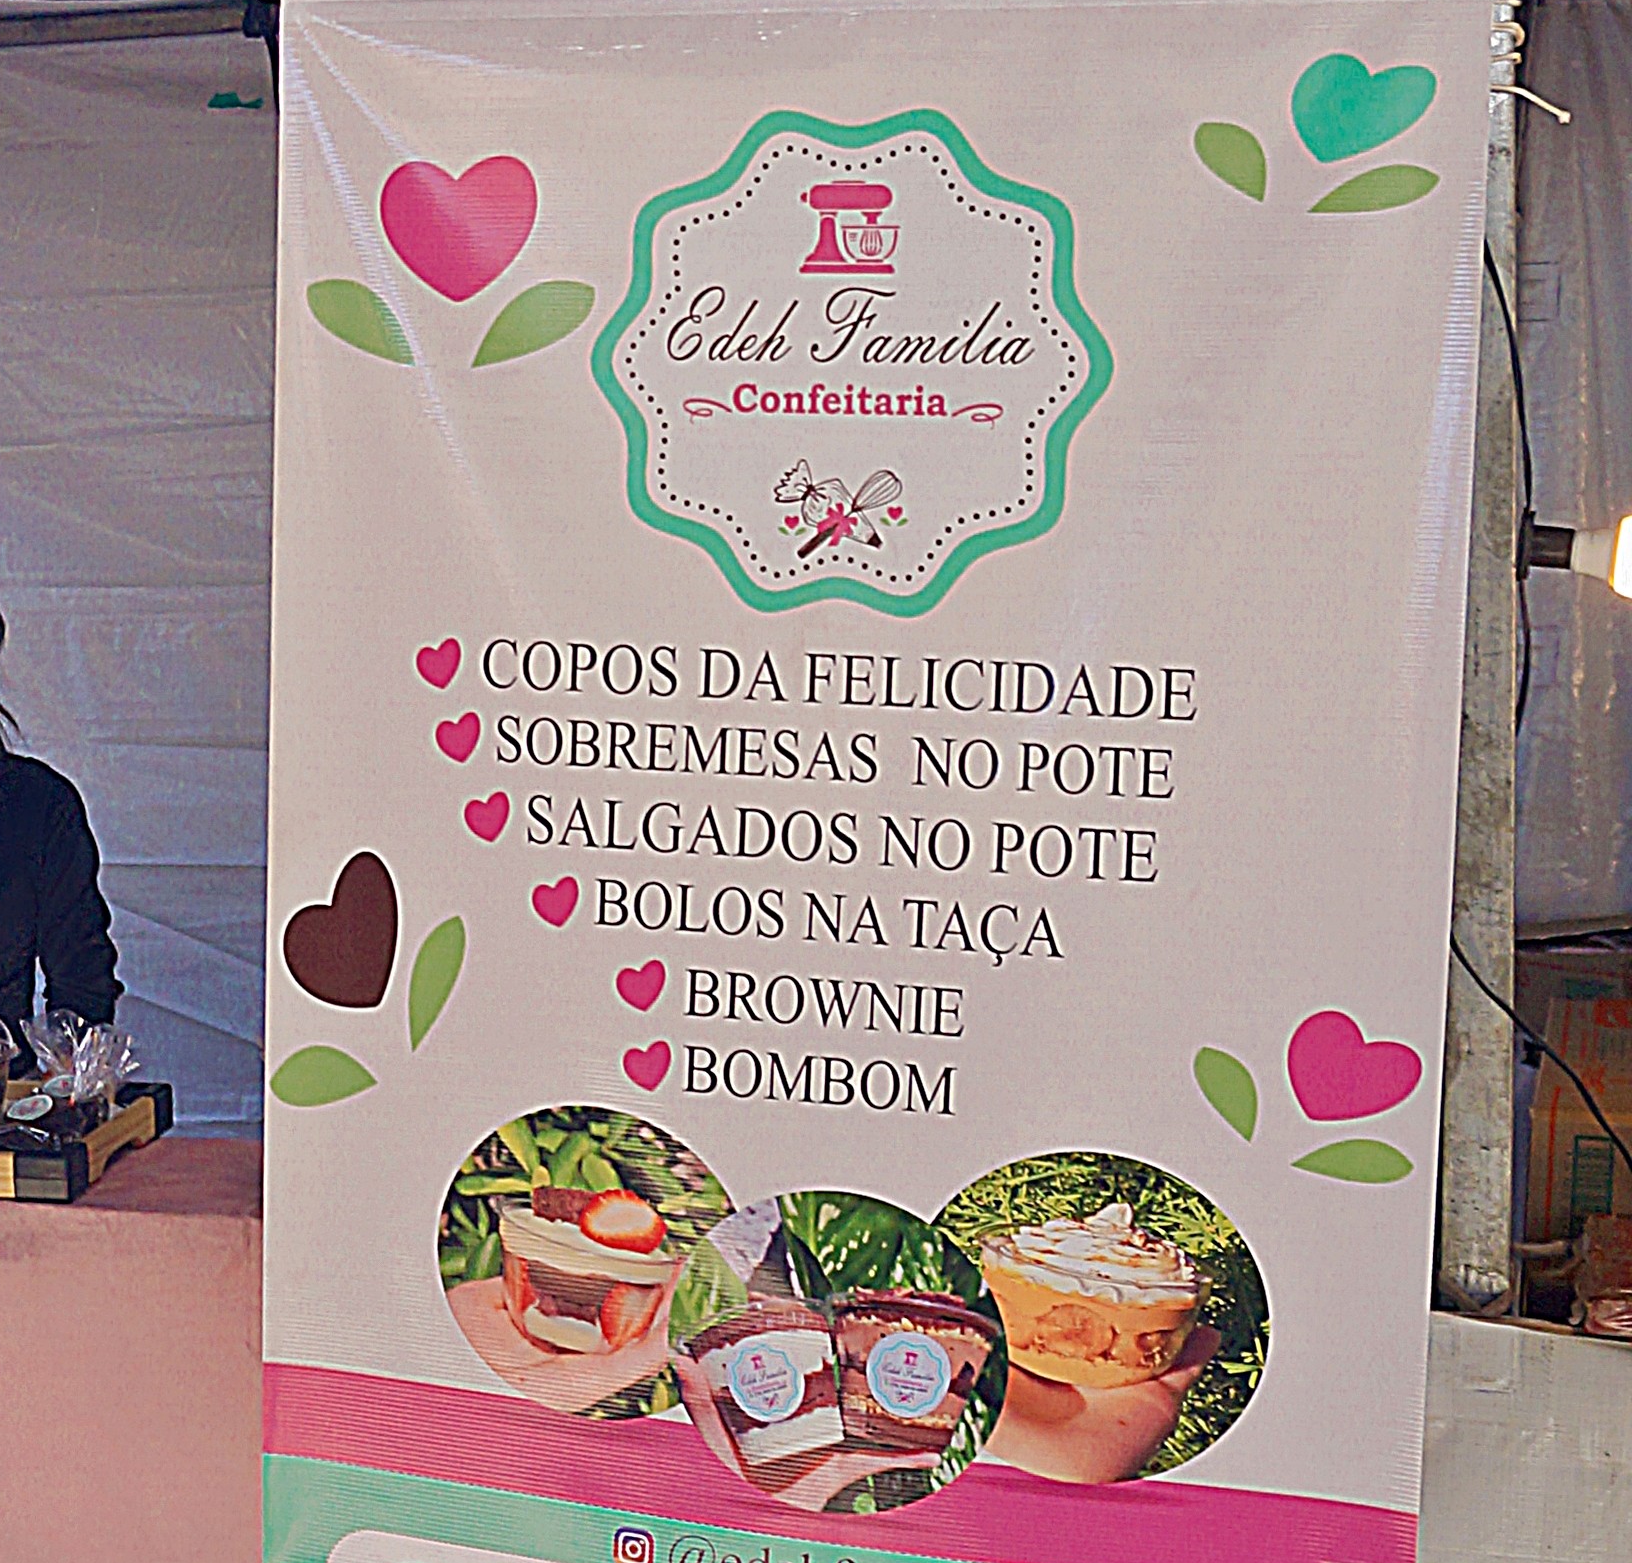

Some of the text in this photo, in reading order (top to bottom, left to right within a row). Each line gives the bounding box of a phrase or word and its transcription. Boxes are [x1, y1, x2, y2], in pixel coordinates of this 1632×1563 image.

[667, 286, 792, 362] Edeh
[732, 383, 948, 417] Confeitaria
[482, 638, 1199, 722] COPOS DA FELICIDADE
[496, 715, 1175, 800] SOBREMESAS NO POTE
[526, 793, 1159, 884] SALGADOS NO POTE
[594, 877, 1065, 968] BOLOS NA TAÇA
[684, 968, 965, 1038] BROWNIE
[684, 1044, 957, 1117] BOMBOM
